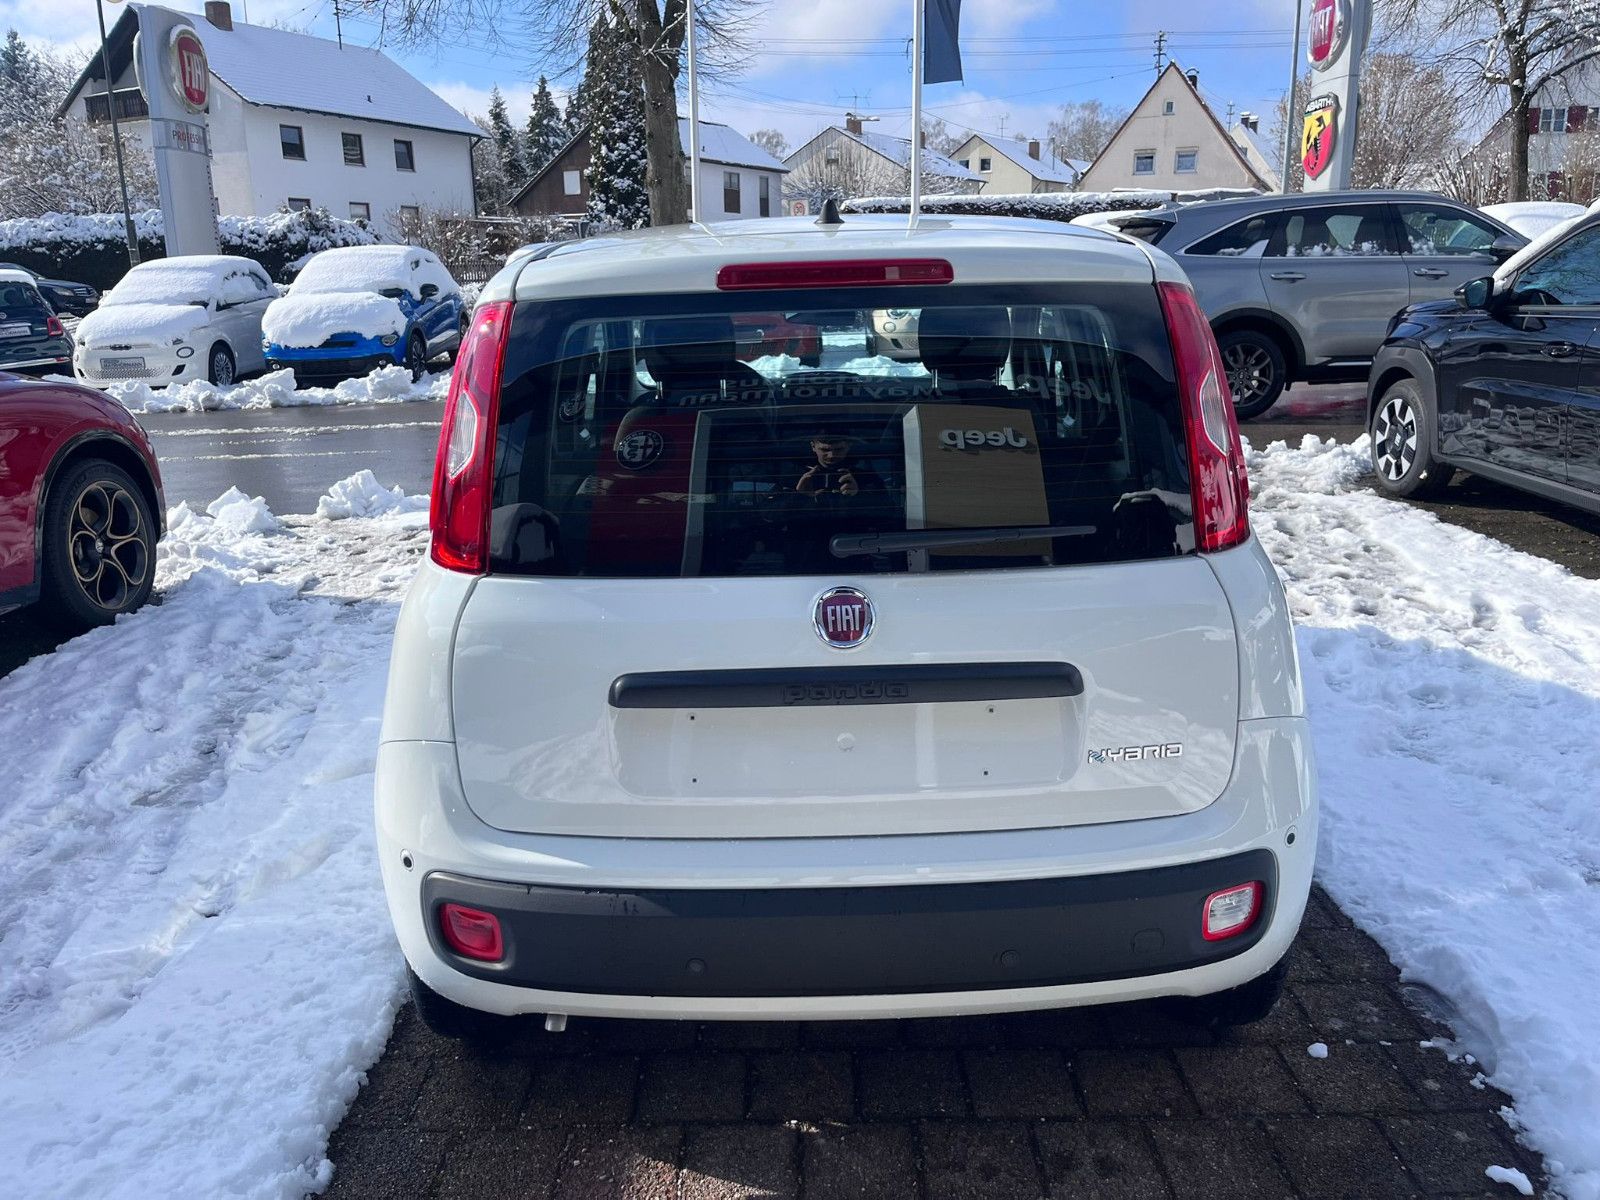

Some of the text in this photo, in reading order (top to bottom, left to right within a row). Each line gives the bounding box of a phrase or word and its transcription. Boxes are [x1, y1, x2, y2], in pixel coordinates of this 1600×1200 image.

[1312, 5, 1333, 48] FIAT
[182, 50, 205, 92] FIAT
[1306, 97, 1334, 113] ABARTH
[827, 604, 861, 632] FIAT
[784, 681, 909, 704] panda
